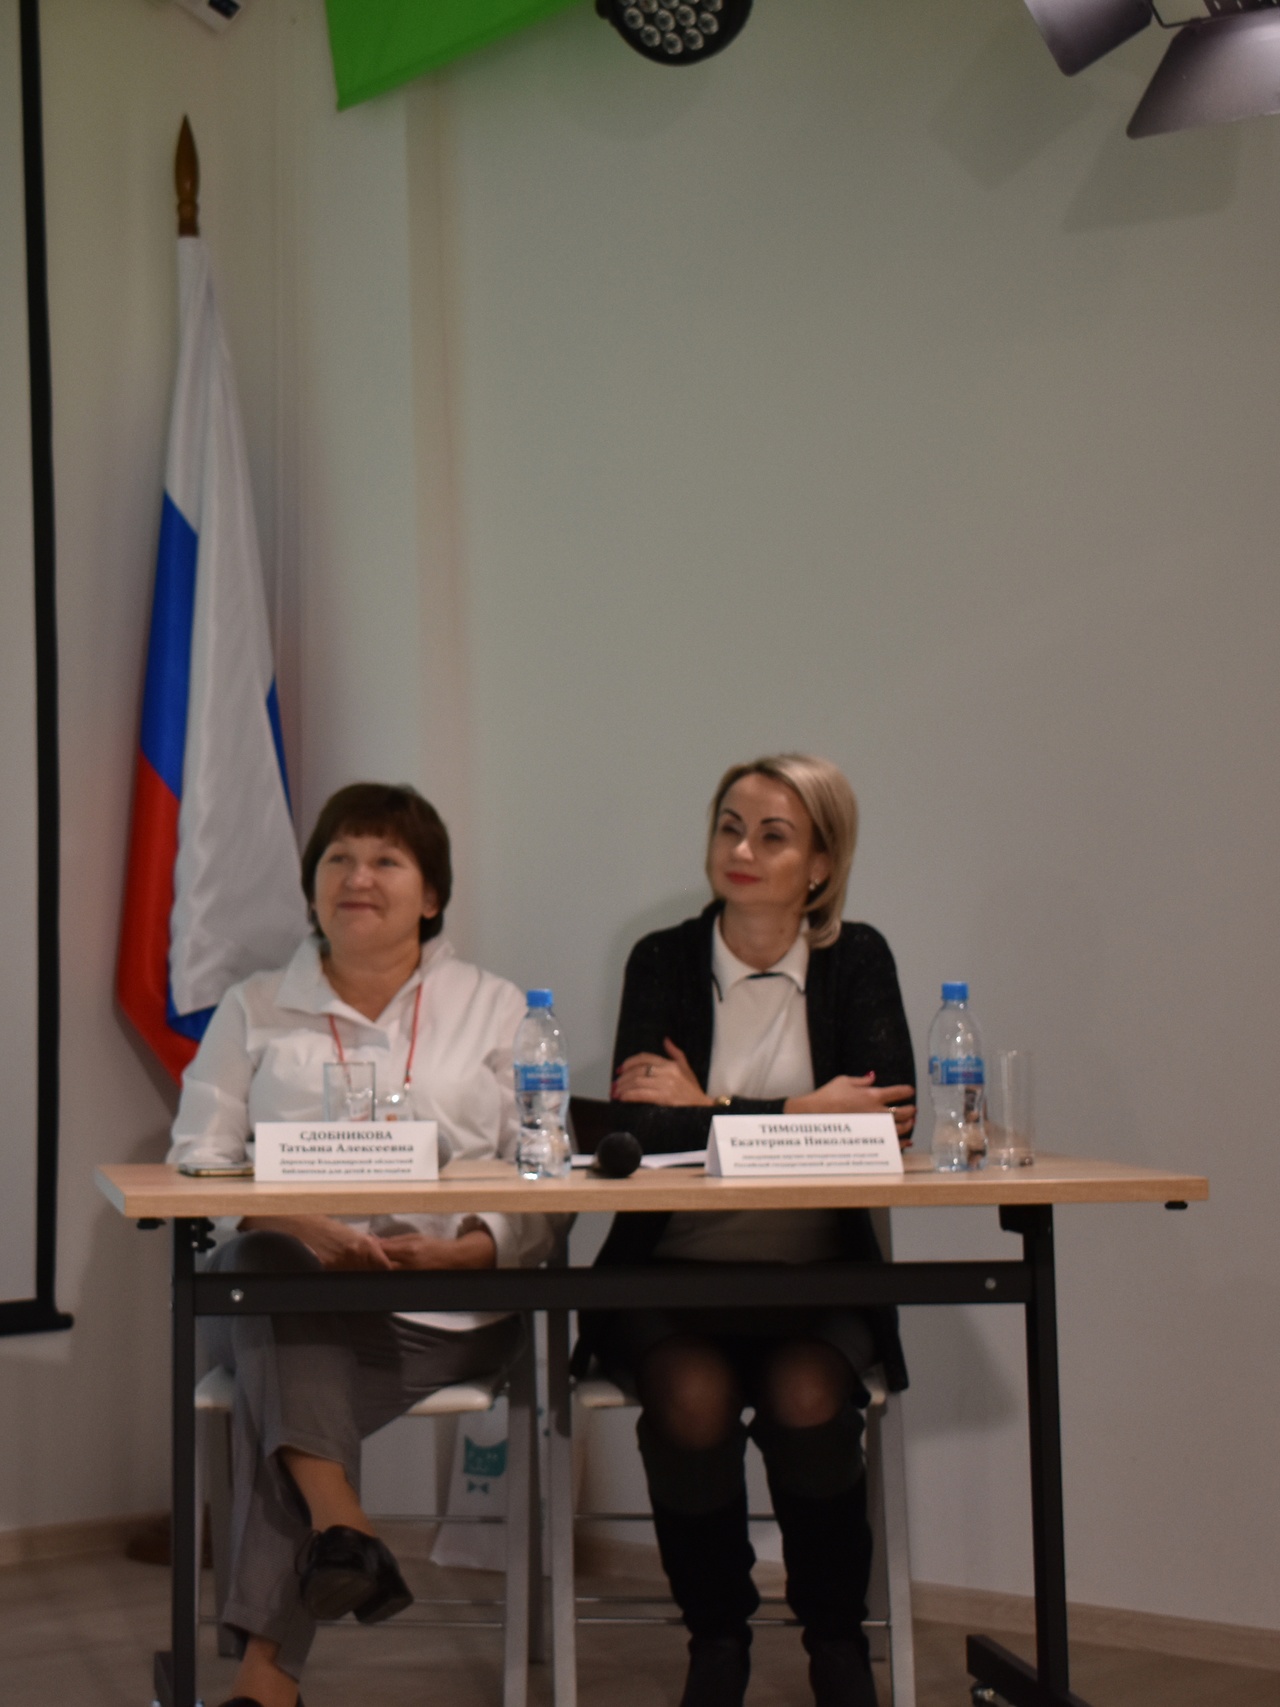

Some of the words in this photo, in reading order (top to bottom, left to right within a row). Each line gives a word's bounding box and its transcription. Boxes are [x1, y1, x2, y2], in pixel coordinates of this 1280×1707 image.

[760, 1123, 852, 1134] ТИМОШКИНА
[300, 1130, 393, 1142] СДОБНИКОВА
[279, 1143, 333, 1153] Татьяна
[336, 1143, 414, 1153] Алексеевна
[730, 1137, 800, 1149] Екатерина
[804, 1136, 885, 1147] Николаевна
